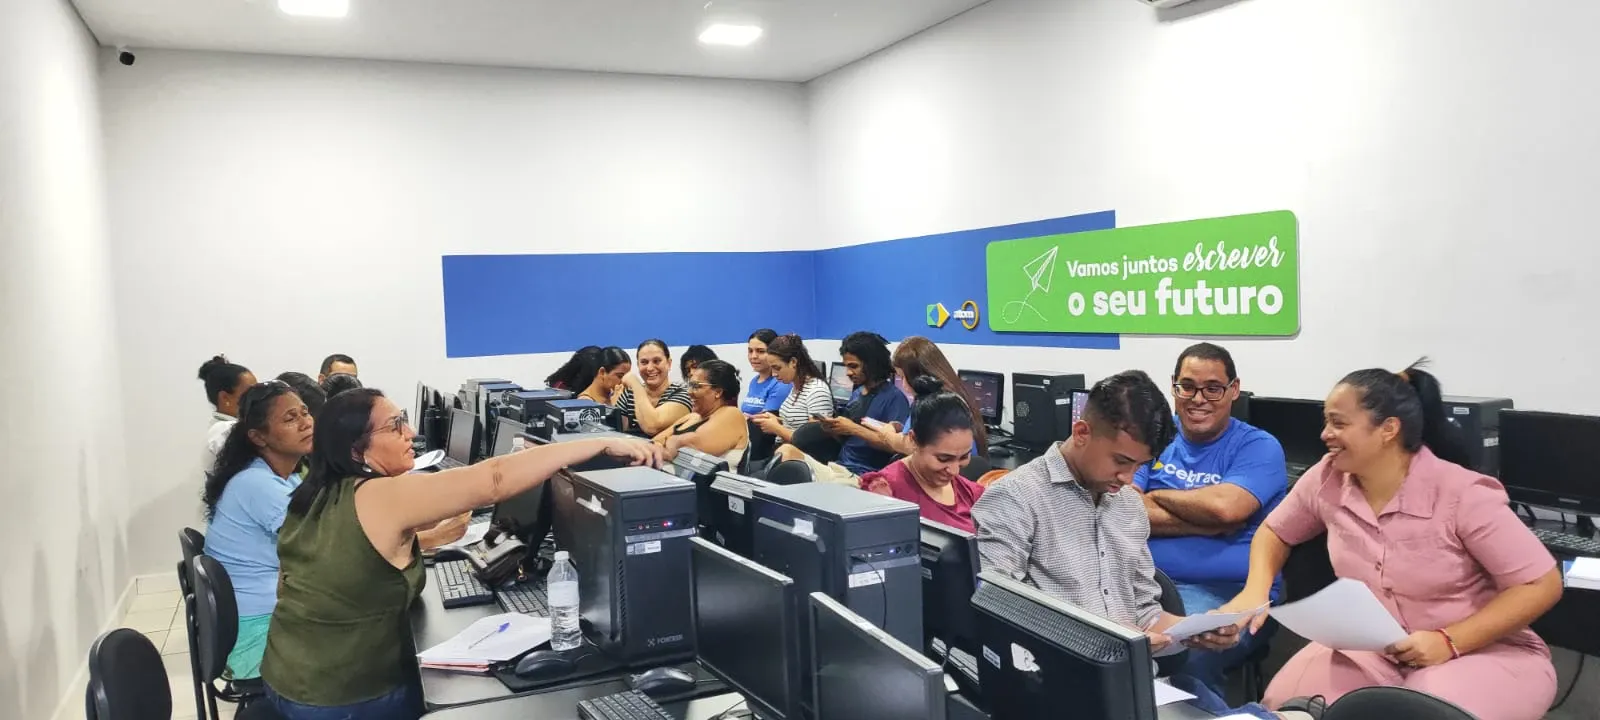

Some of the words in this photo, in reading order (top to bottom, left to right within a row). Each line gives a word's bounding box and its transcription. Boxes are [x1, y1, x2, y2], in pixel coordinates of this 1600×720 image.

[1066, 260, 1119, 278] Vamos
[1122, 255, 1178, 280] juntos
[1182, 235, 1286, 272] escrever
[1068, 291, 1086, 317] o
[1092, 289, 1147, 316] seu
[1154, 276, 1284, 316] futuro
[1163, 463, 1222, 485] cebrac
